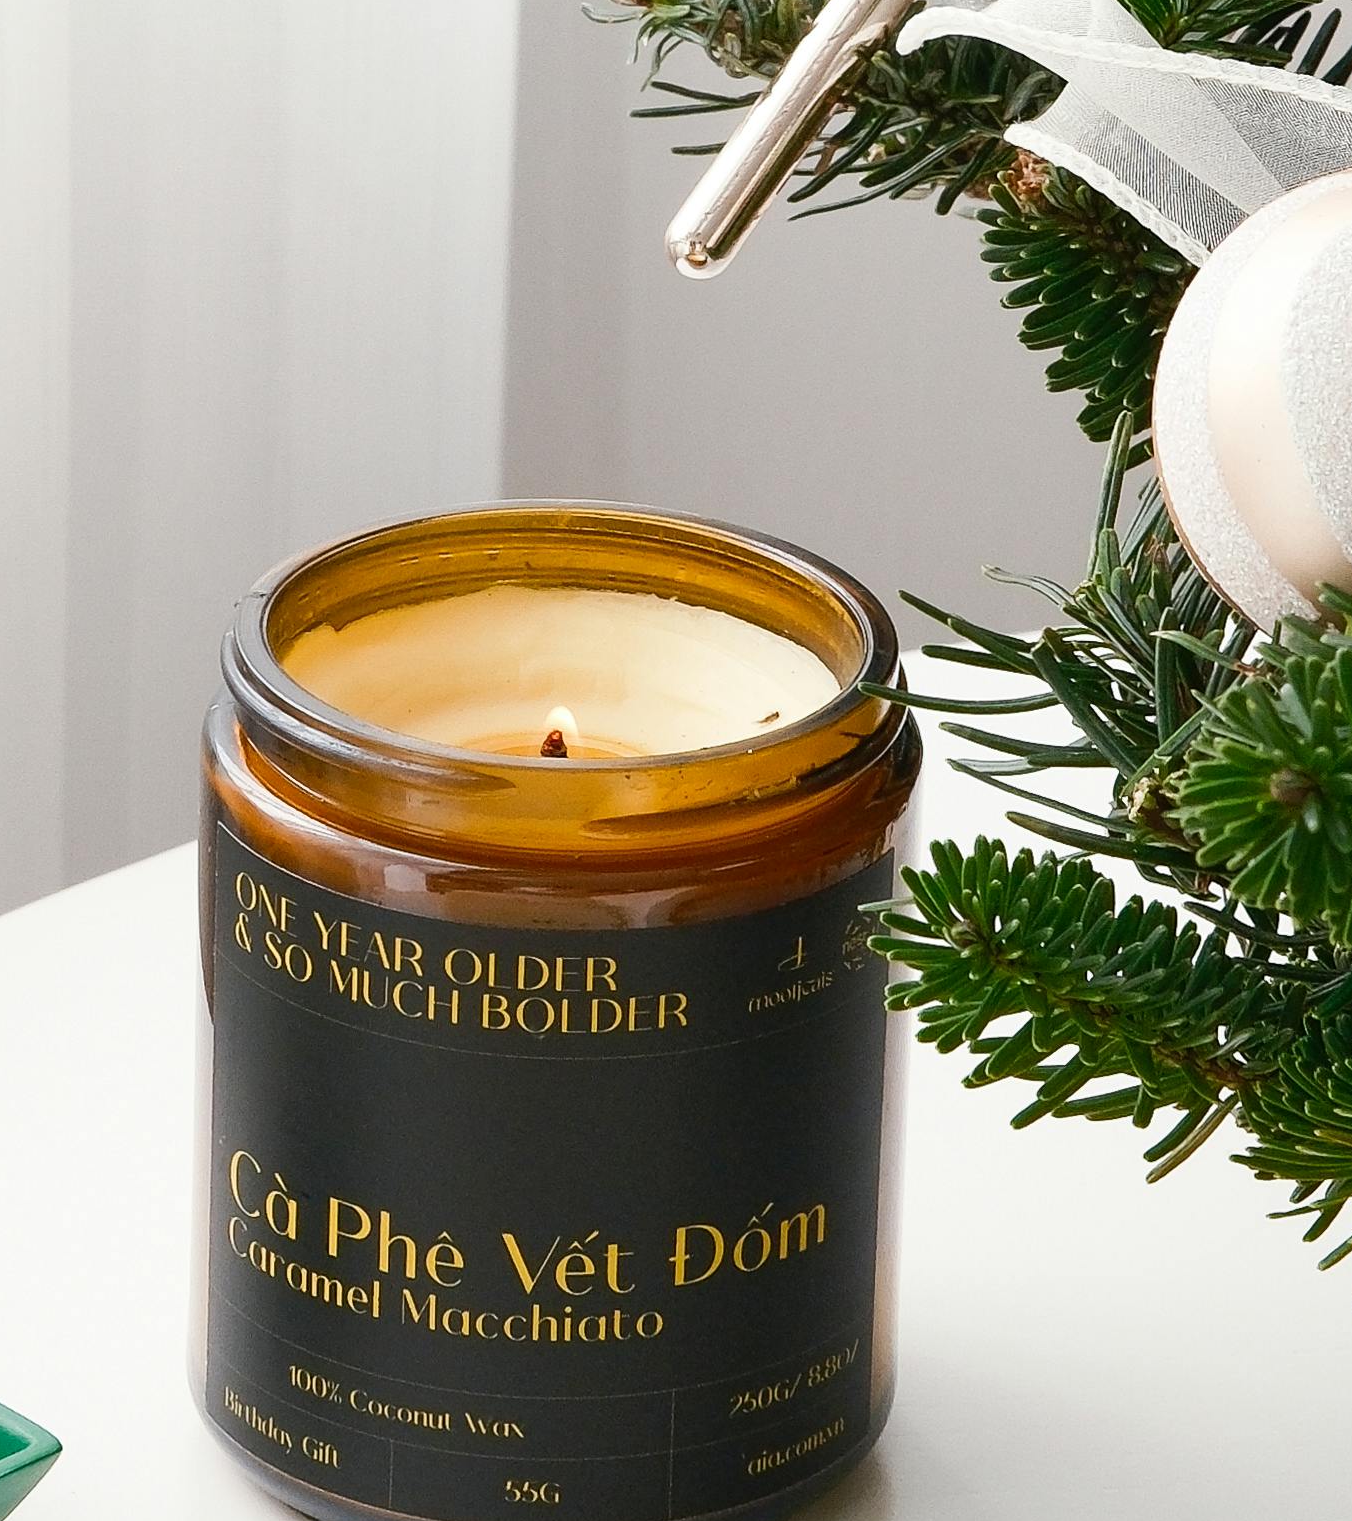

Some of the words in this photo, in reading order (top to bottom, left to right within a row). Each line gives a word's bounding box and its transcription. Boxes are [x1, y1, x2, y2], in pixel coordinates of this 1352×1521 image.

[234, 912, 252, 954] &
[263, 931, 313, 983] SO
[329, 958, 459, 1025] MUCH
[481, 992, 688, 1034] BOLDER
[235, 871, 298, 938] ONE
[313, 910, 424, 977] YEAR
[444, 948, 617, 992] OLDER
[229, 1216, 380, 1319] Caramel
[401, 1288, 664, 1342] Macchiato
[230, 1150, 298, 1241] Cà
[328, 1196, 465, 1288] Phê
[501, 1230, 636, 1296] Vết
[668, 1202, 826, 1287] Đốm
[224, 1386, 293, 1455] Birthday
[302, 1435, 339, 1469] Gift
[288, 1365, 343, 1404] 100%
[349, 1389, 451, 1432] Coconut
[464, 1412, 525, 1439] Wax
[504, 1480, 560, 1504] 55G
